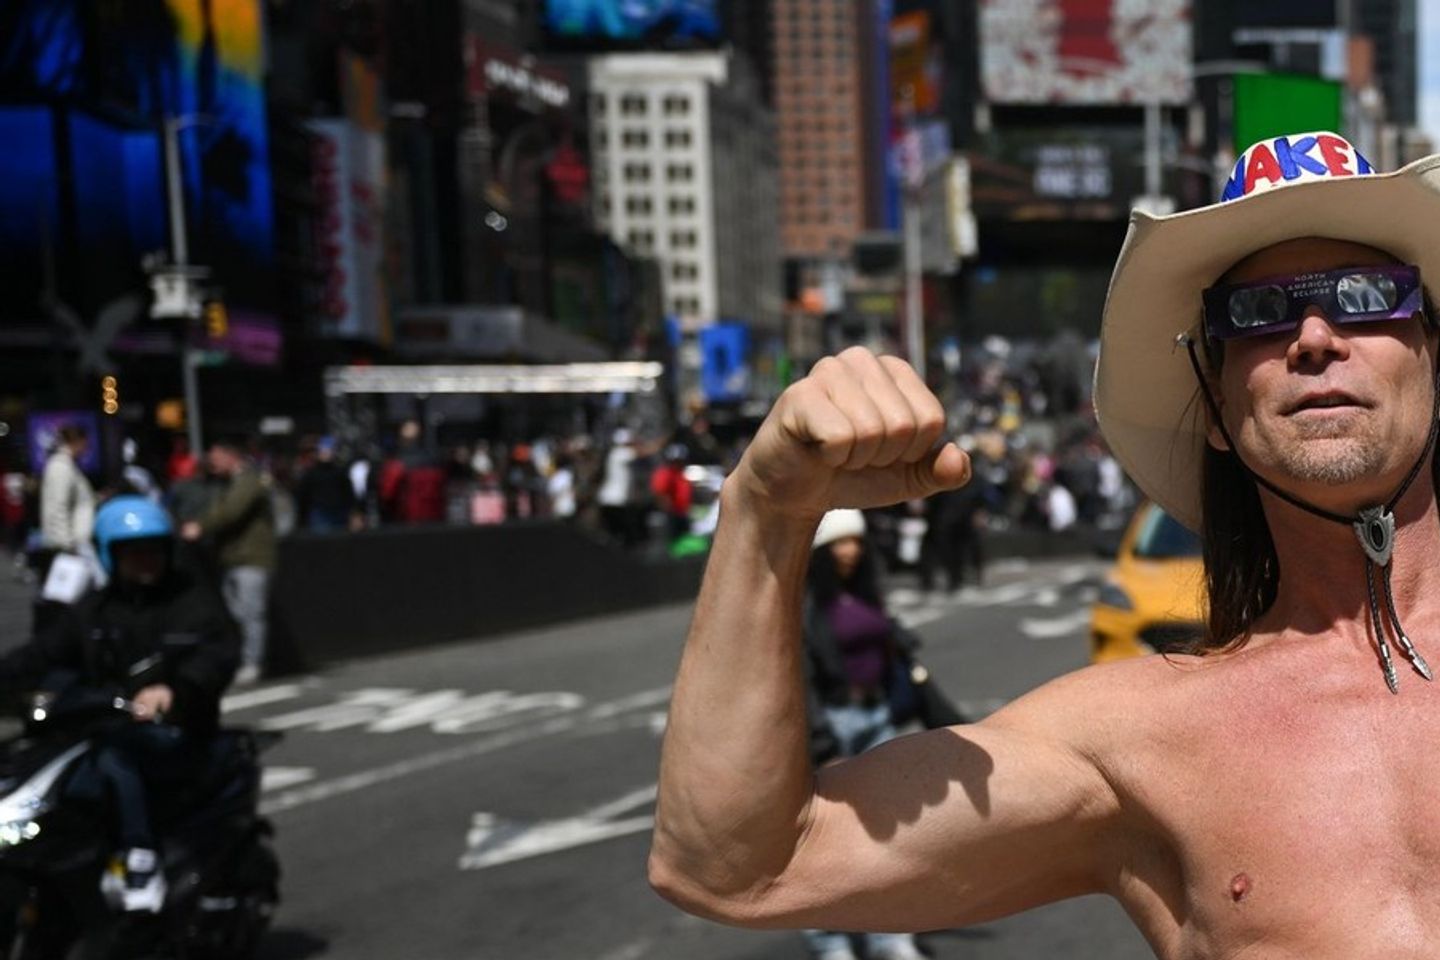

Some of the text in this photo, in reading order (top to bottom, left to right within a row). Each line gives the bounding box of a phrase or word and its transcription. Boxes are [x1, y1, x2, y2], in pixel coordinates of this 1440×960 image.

[1294, 273, 1326, 282] NORTH
[1287, 280, 1335, 291] AMERICAN
[1293, 288, 1330, 298] ECLIPSE
